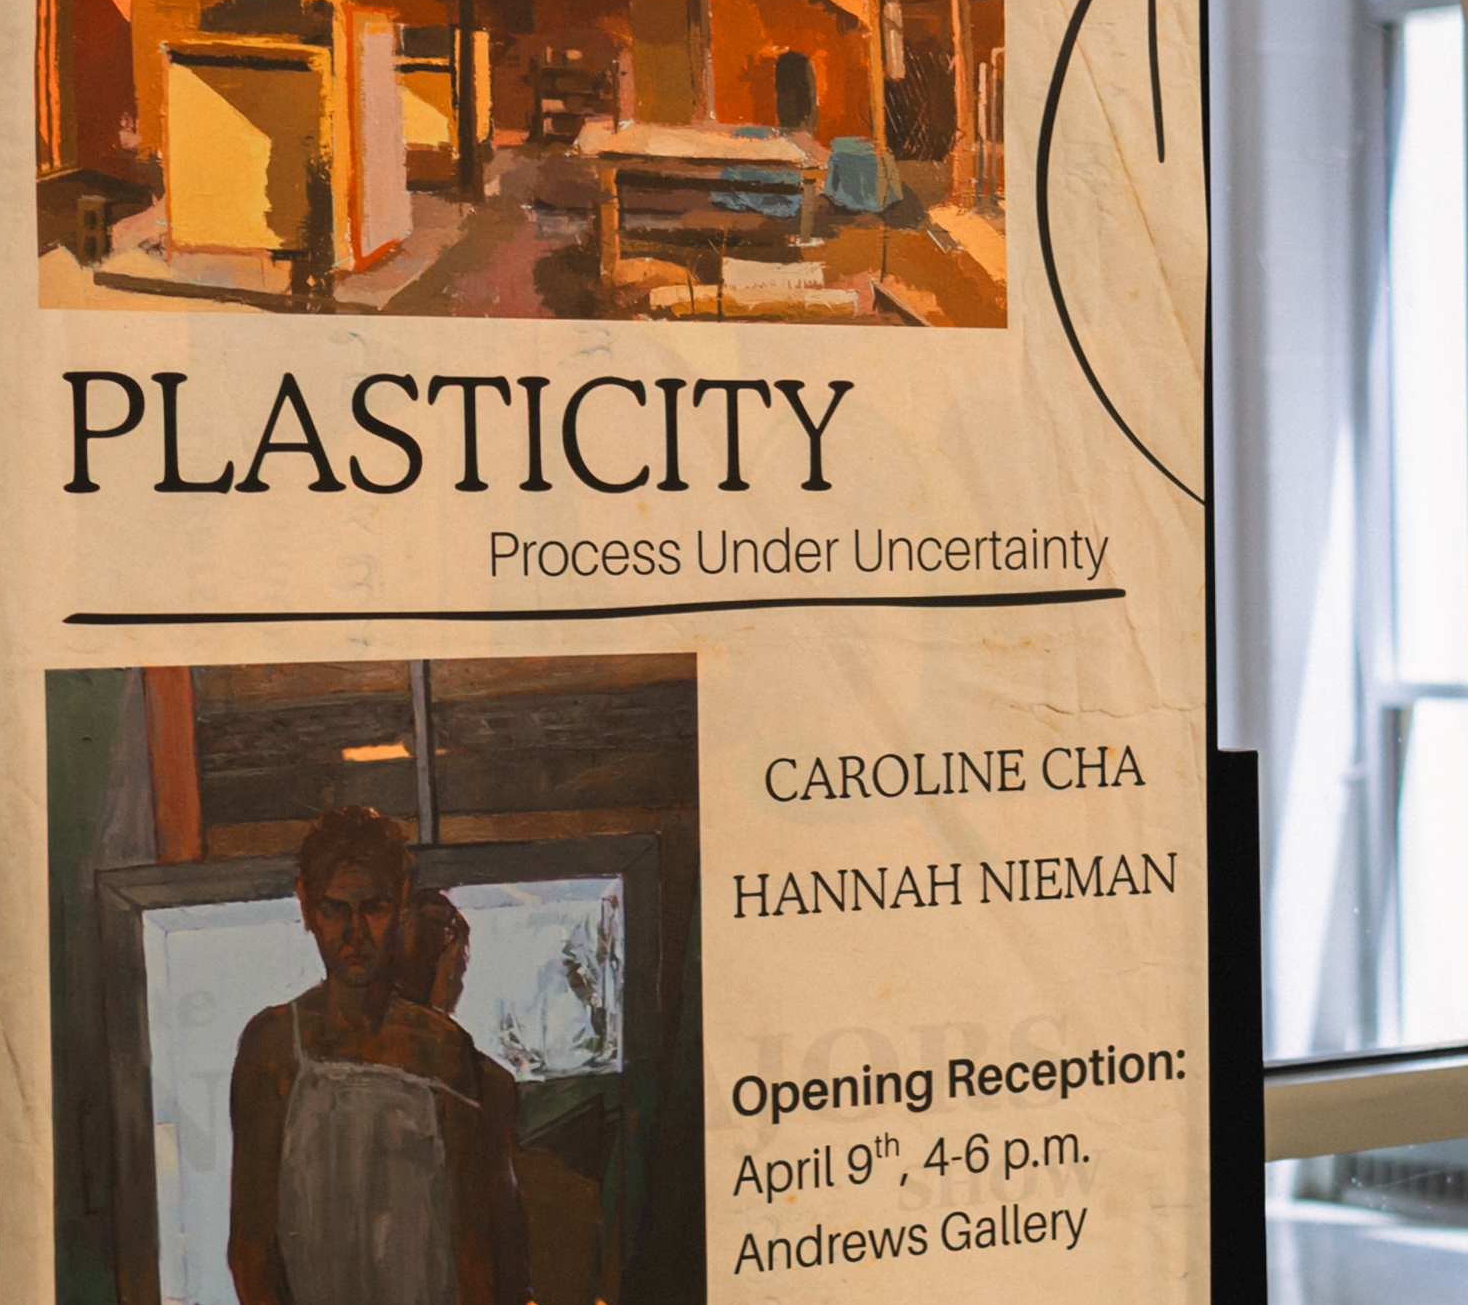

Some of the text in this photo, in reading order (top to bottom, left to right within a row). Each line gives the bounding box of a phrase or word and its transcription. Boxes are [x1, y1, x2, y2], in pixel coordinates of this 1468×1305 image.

[62, 371, 855, 495] PLASTICITY
[491, 527, 1109, 581] Process Under Uncertainty
[765, 745, 1146, 802] CAROLINE CHA
[733, 852, 1178, 919] HANNAH NIEMAN
[732, 1044, 1186, 1125] Opening Reception:
[733, 1132, 1092, 1204] April 9th, 4-6 p.m.
[734, 1203, 1087, 1275] Andrews Gallery
